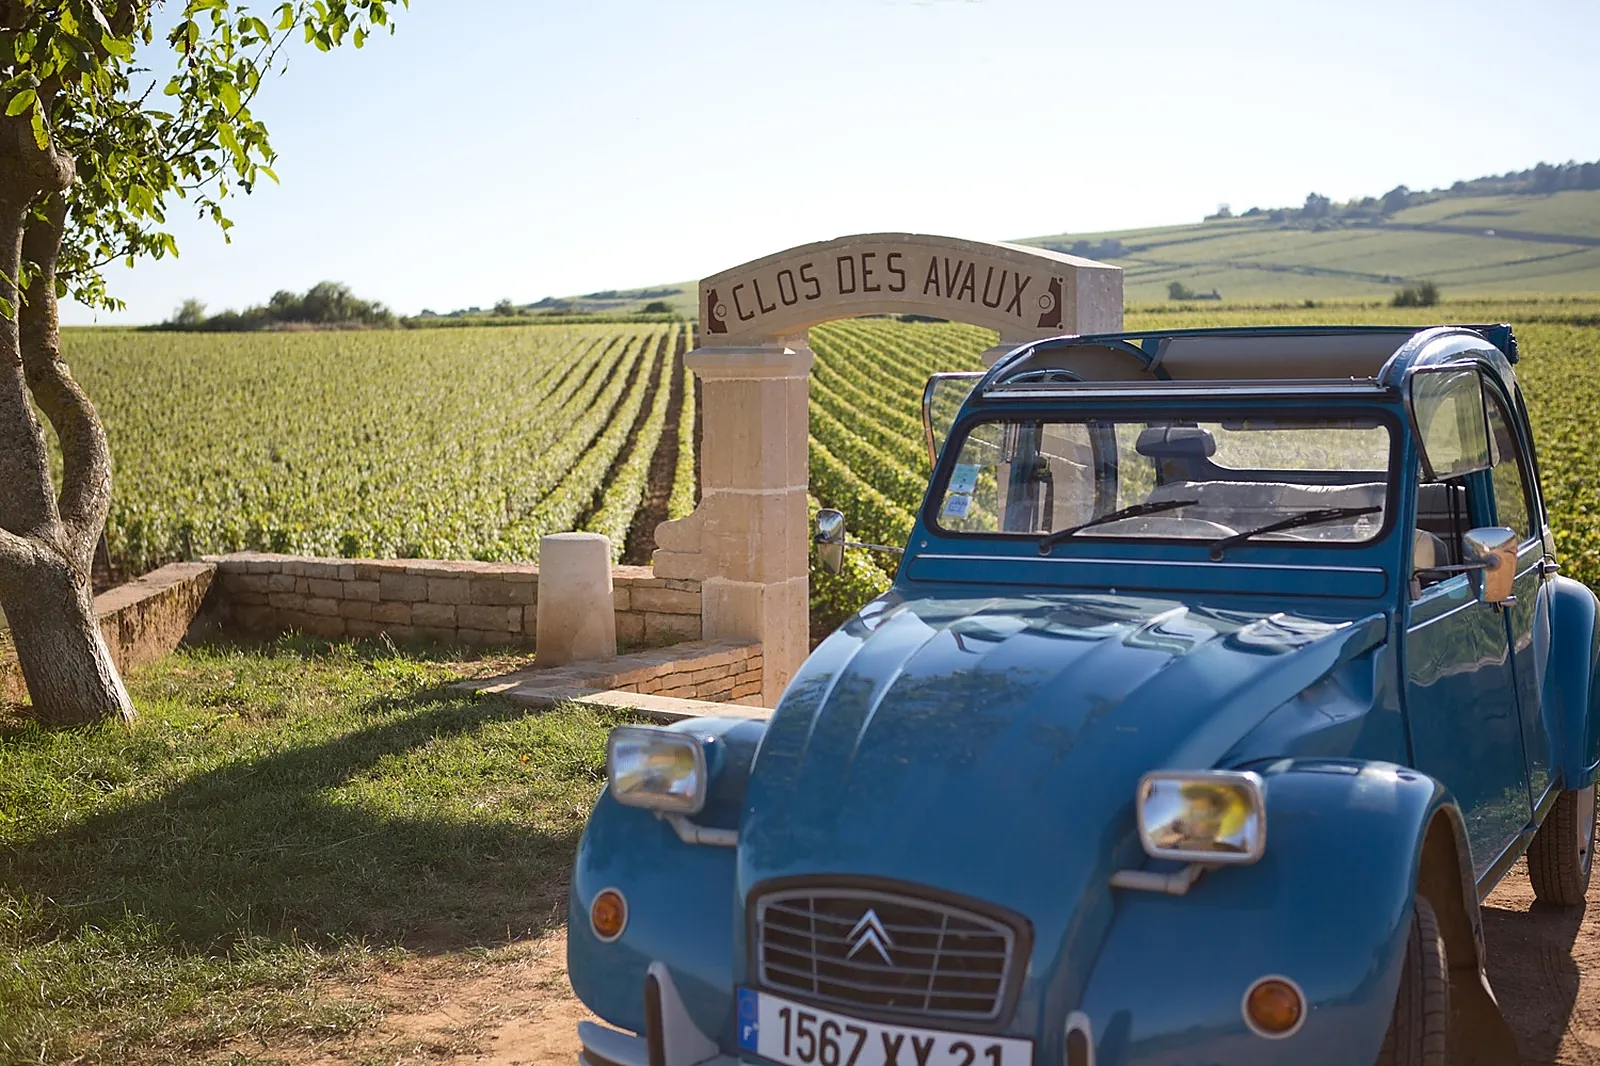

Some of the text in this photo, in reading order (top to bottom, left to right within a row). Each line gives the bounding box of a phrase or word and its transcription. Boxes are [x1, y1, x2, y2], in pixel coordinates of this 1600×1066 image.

[732, 252, 1032, 320] CLOS DES AVAUX
[778, 1006, 868, 1066] 1567
